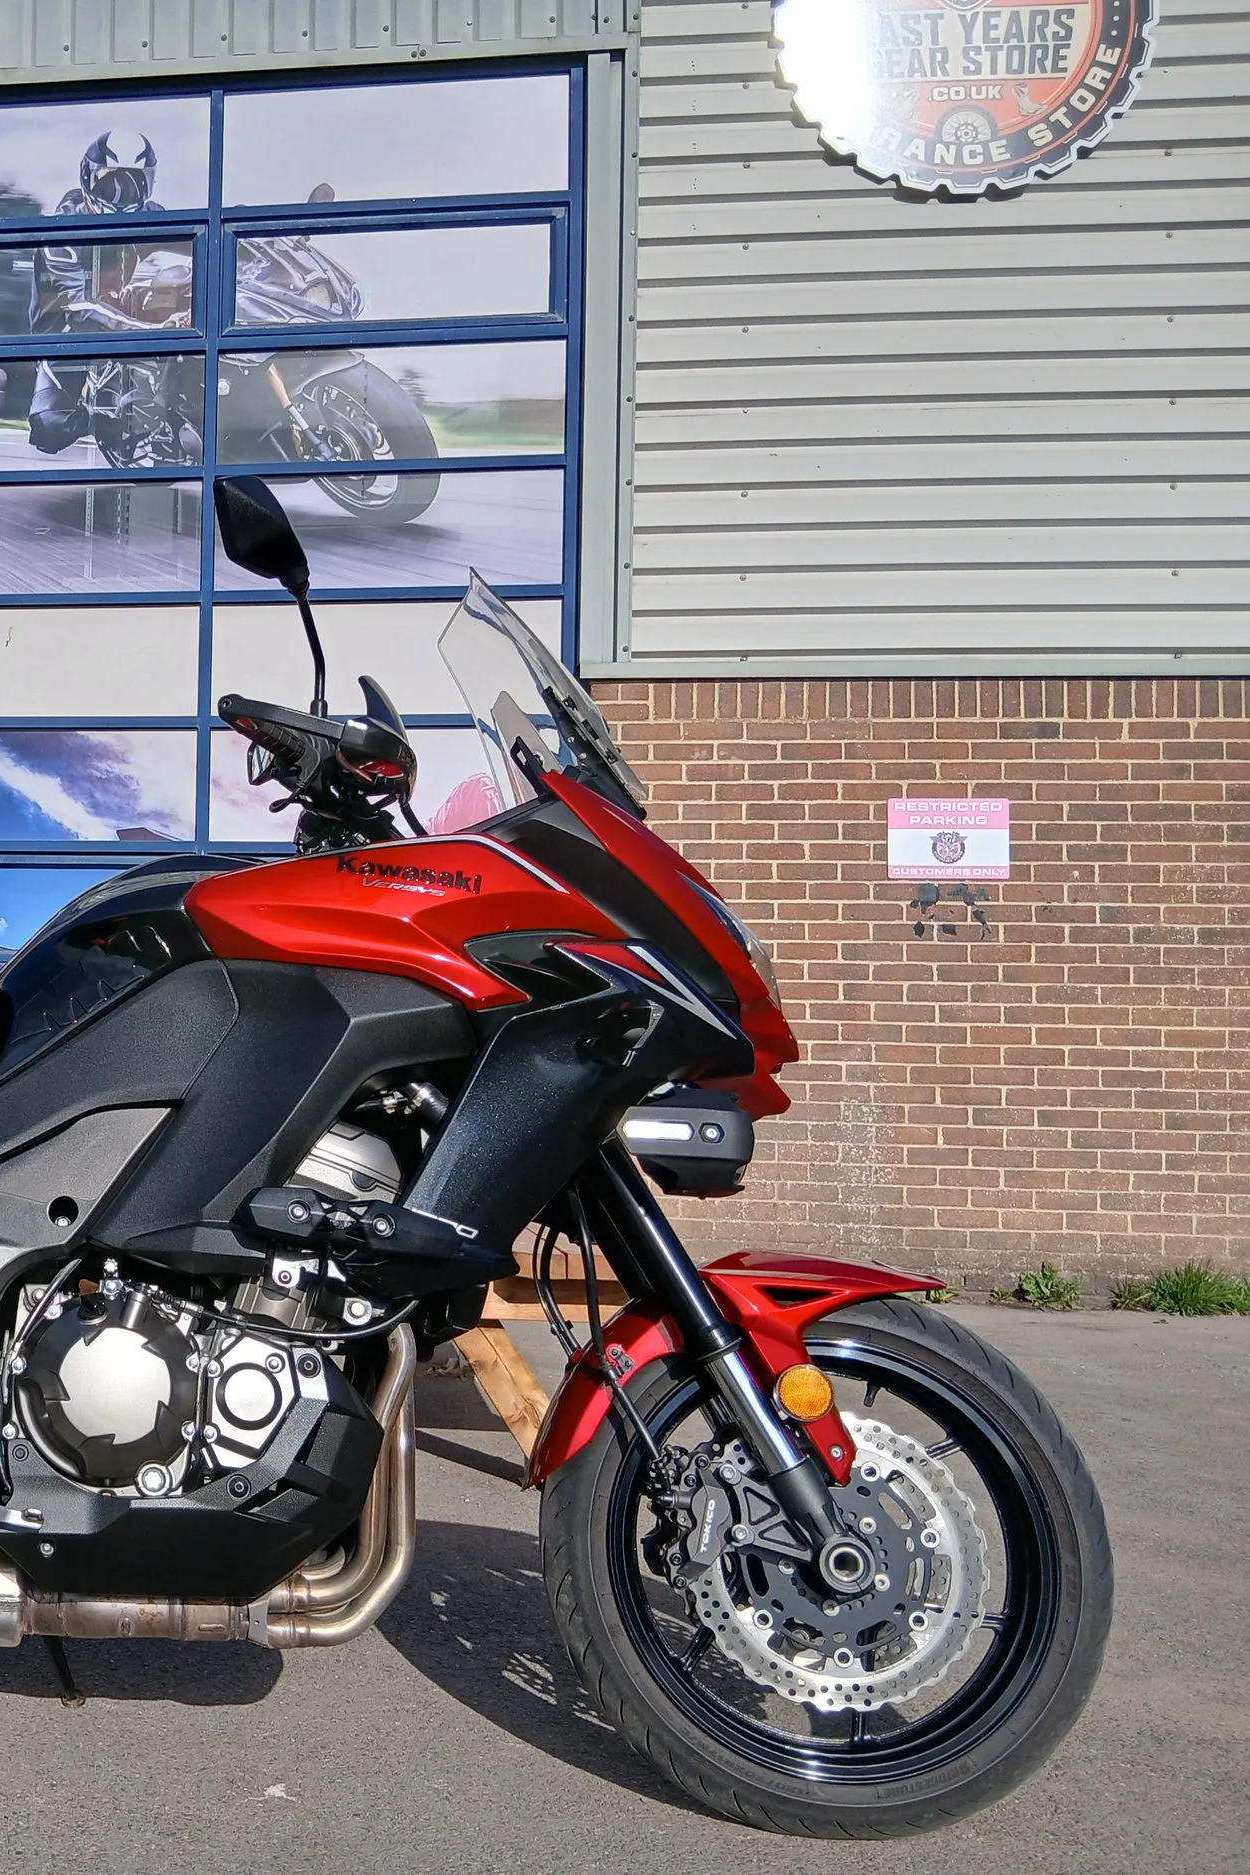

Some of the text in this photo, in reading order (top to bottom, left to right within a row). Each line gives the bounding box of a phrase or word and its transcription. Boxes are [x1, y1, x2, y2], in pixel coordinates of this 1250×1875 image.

[876, 8, 1075, 46] AST YEARS
[963, 43, 1069, 76] STORE
[928, 84, 1003, 102] .CO.UK
[1027, 43, 1122, 148] STORE
[894, 802, 1003, 812] RESTRICTED
[909, 815, 988, 825] PARKING
[337, 856, 482, 894] Kawasaki
[891, 867, 1006, 876] CUSTOMERS ONLY
[699, 1499, 716, 1553] TOKICO
